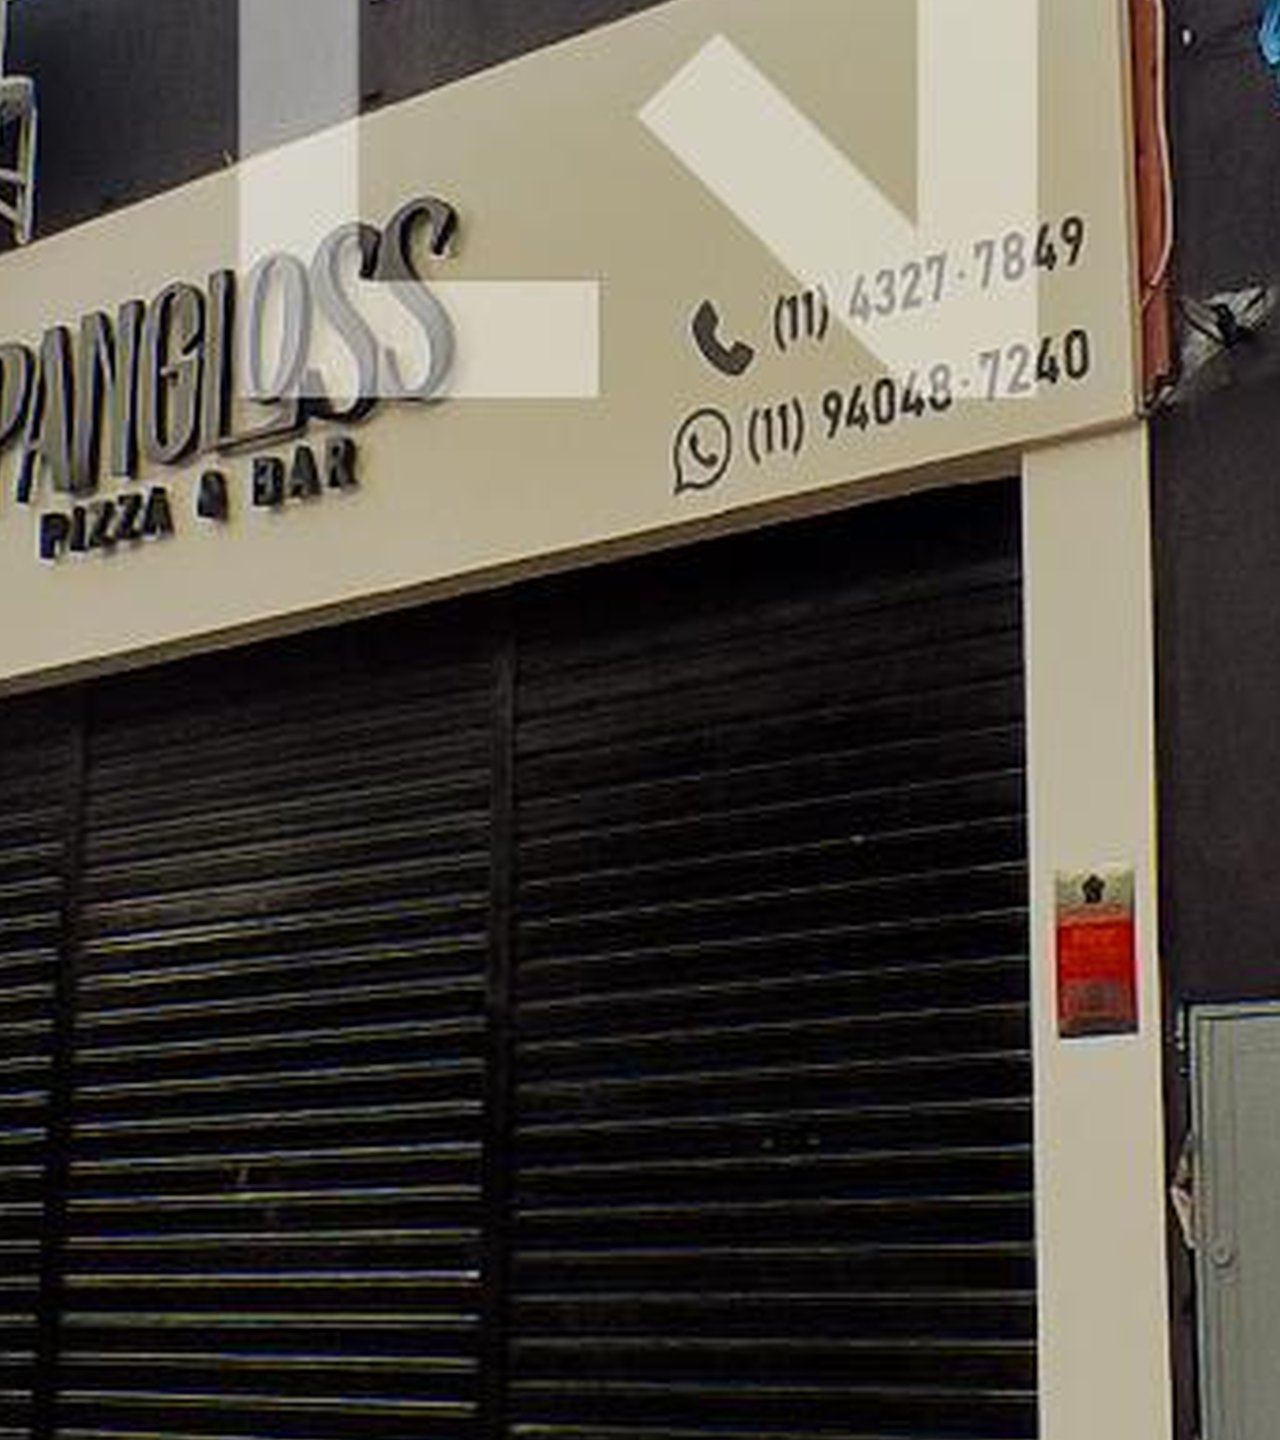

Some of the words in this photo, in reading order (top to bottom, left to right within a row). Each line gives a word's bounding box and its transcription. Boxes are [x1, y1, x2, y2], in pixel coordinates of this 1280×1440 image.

[774, 283, 829, 351] (11)
[748, 396, 804, 464] (11)
[40, 487, 173, 559] PIZZA
[252, 436, 355, 507] BAR
